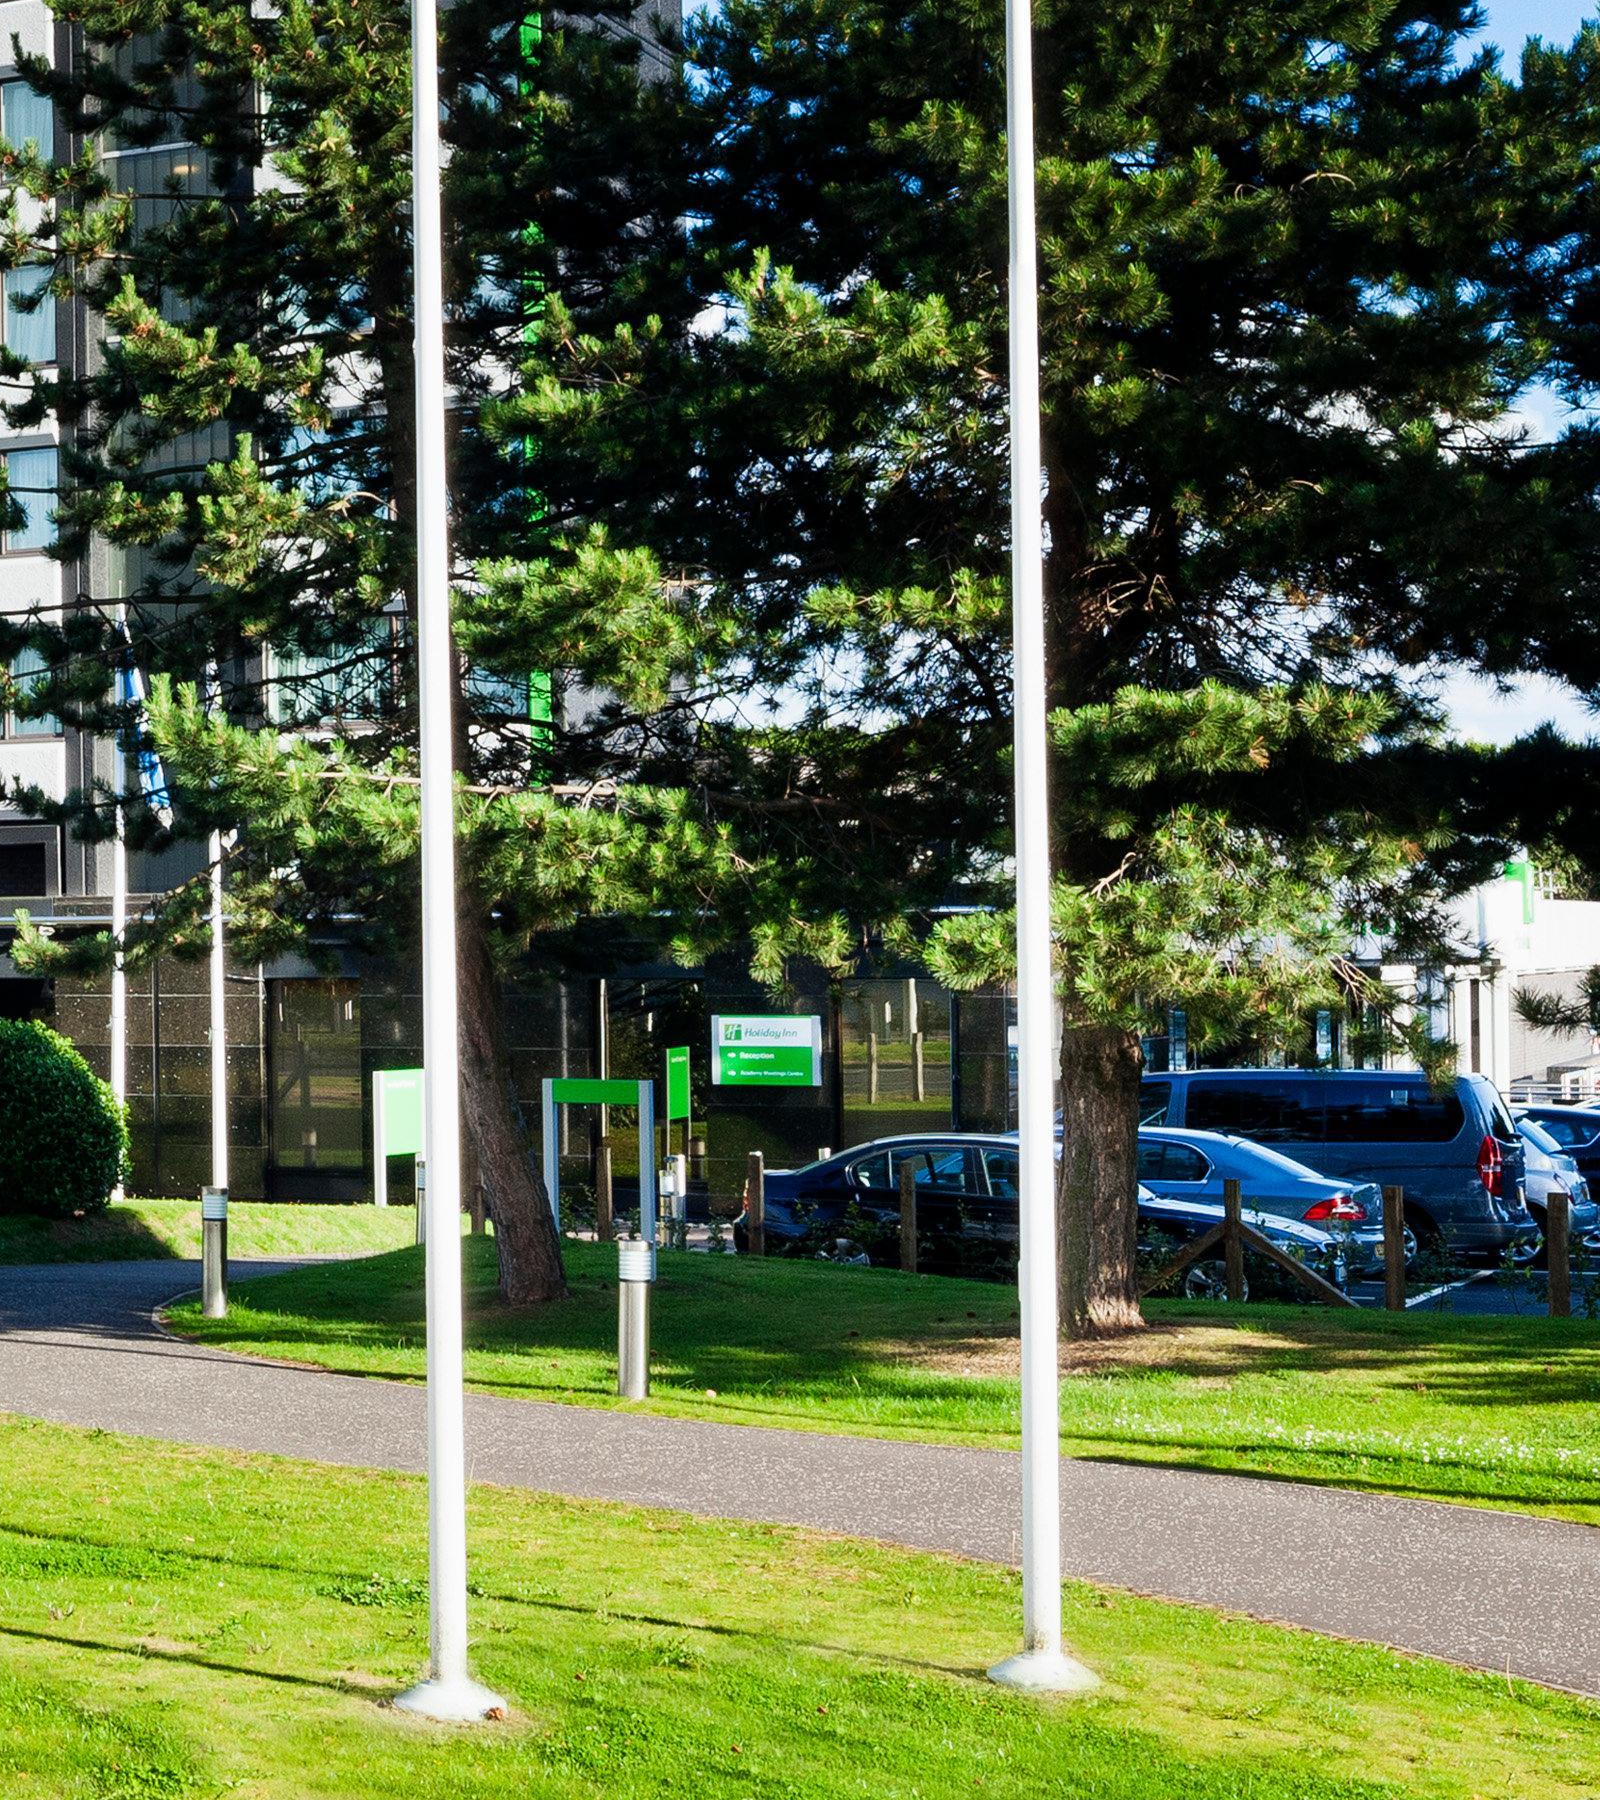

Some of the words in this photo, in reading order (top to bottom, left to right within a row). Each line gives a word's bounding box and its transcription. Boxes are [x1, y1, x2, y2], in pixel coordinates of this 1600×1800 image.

[744, 1027, 781, 1039] Holiday
[782, 1027, 798, 1038] Inn
[739, 1051, 775, 1060] Reception
